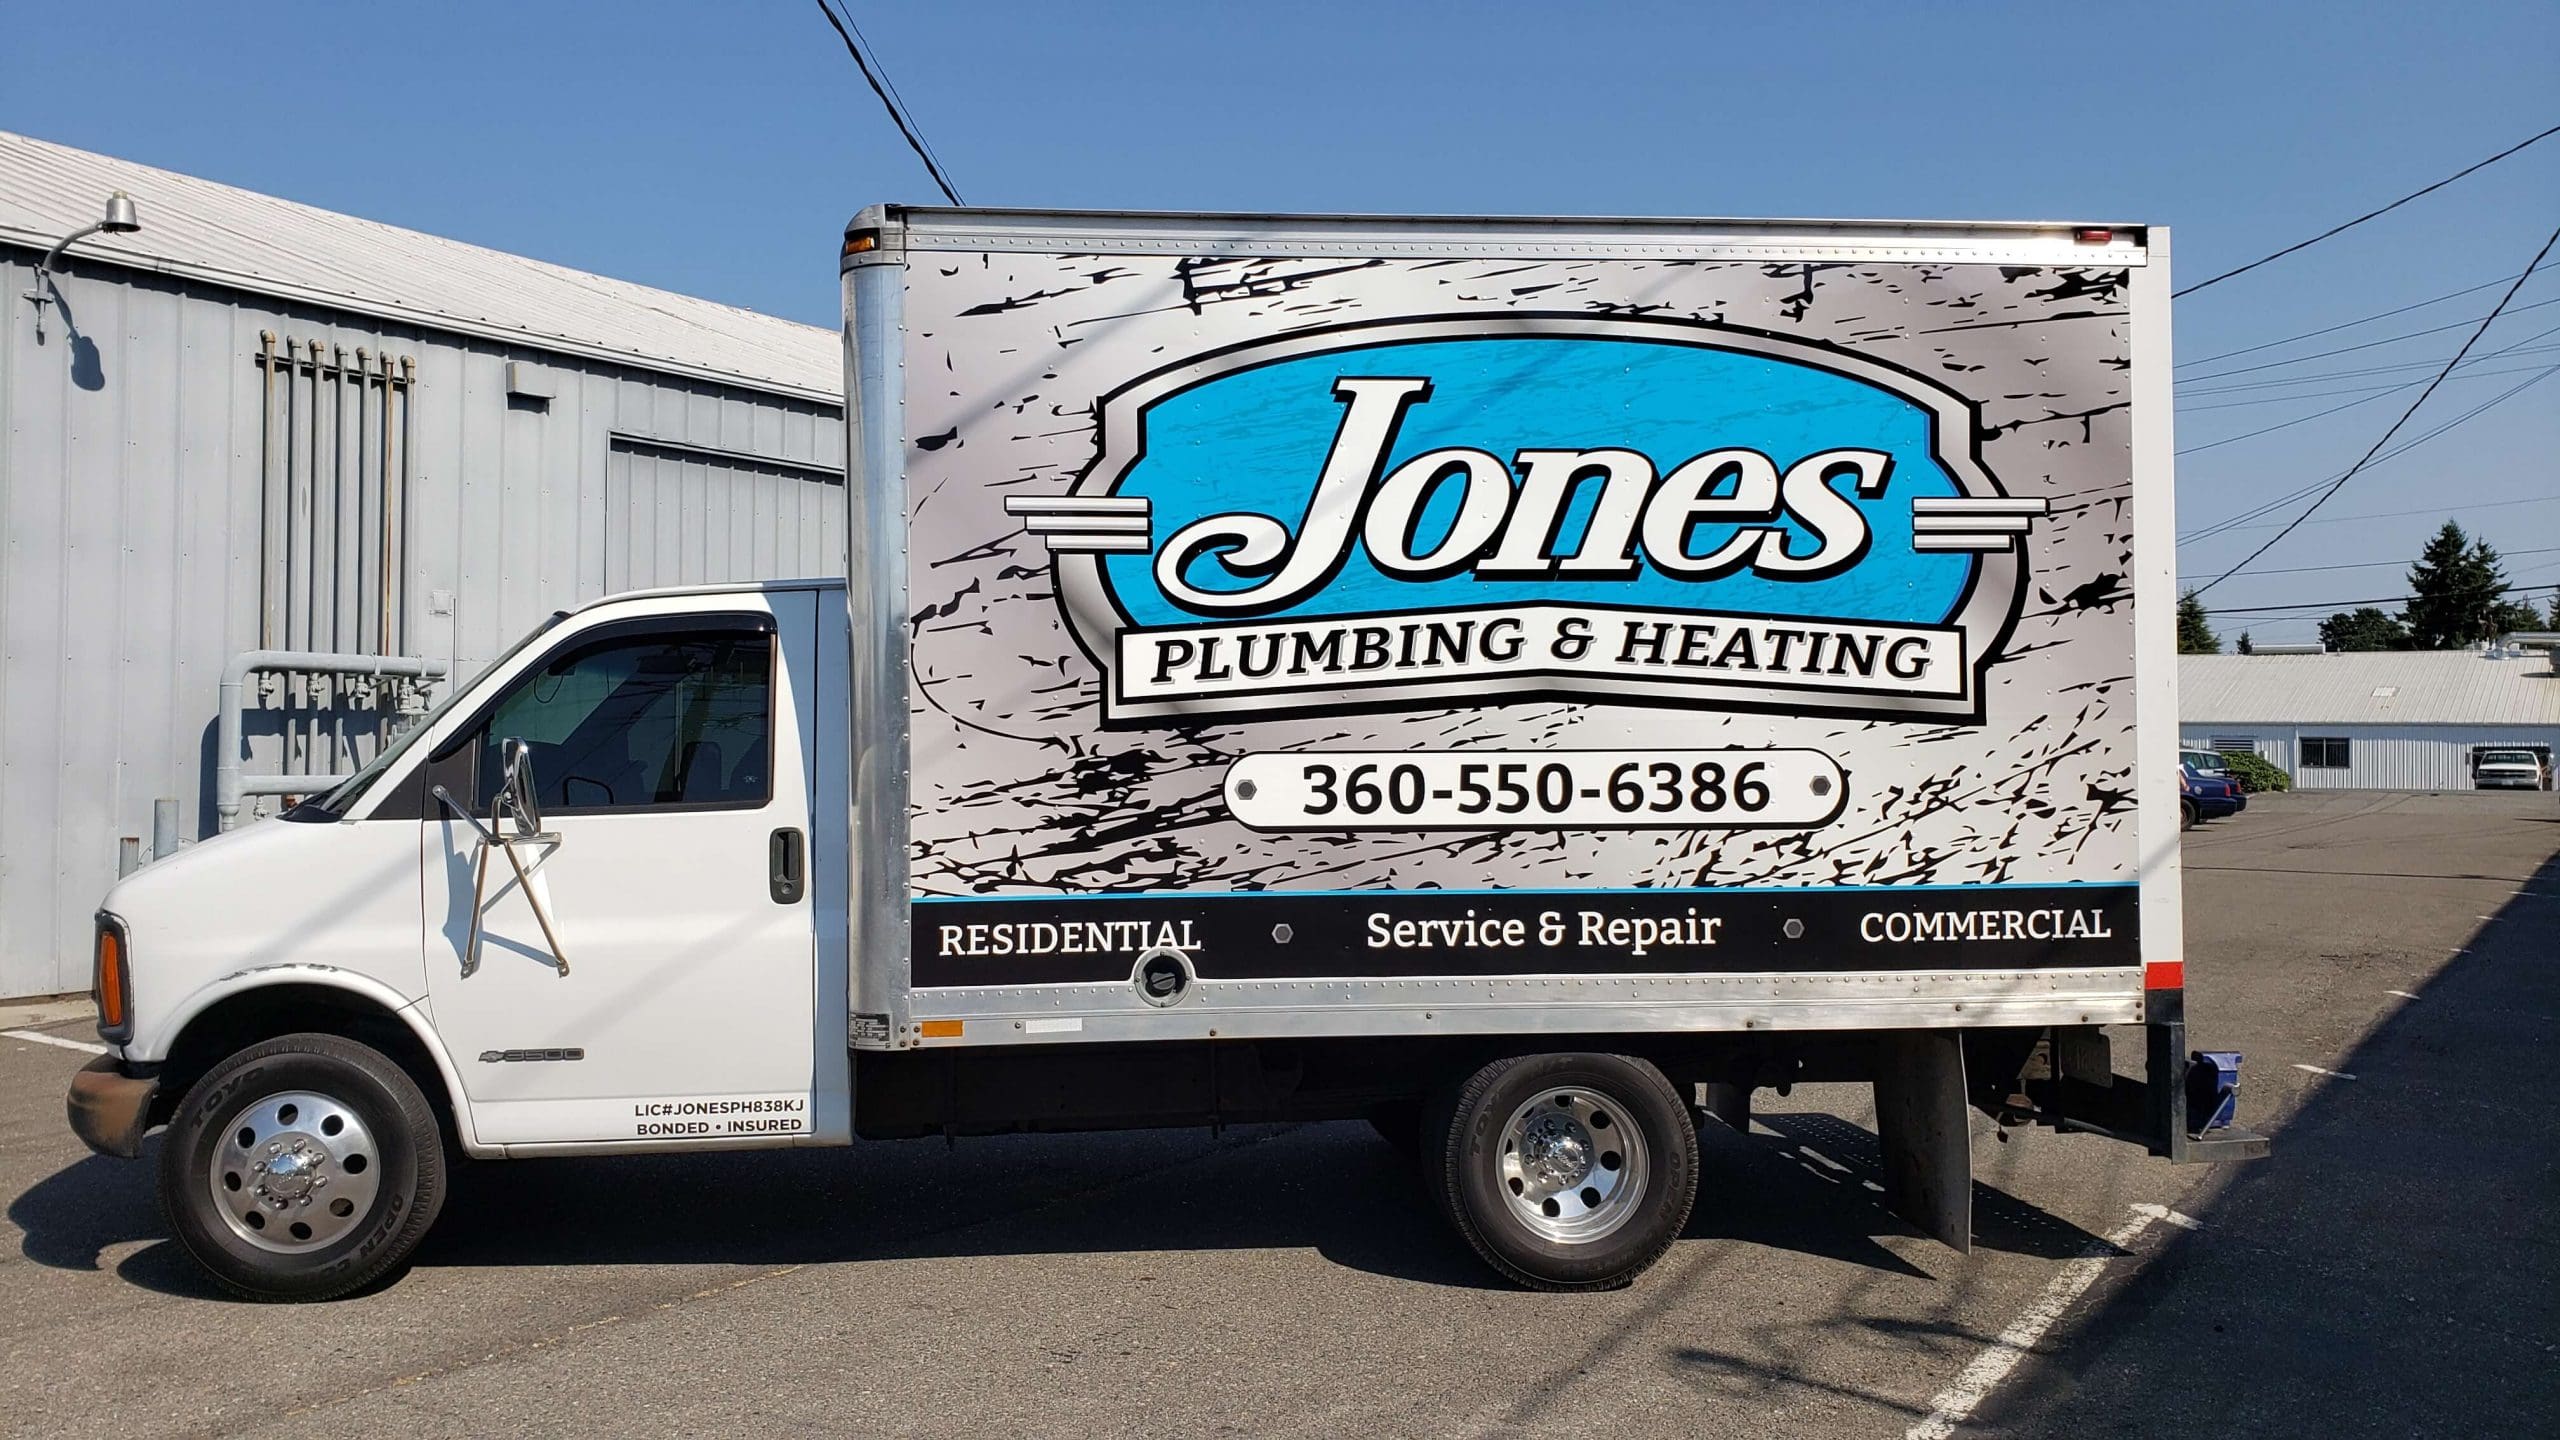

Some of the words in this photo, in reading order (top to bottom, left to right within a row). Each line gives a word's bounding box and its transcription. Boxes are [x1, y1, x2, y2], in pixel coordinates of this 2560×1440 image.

[1152, 376, 1896, 617] Jones
[1150, 617, 1527, 684] PLUMBING
[1550, 616, 1595, 661] &
[1615, 620, 1932, 681] HEATING
[1302, 761, 1772, 816] 360-550-6386
[938, 919, 1202, 956] RESIDENTIAL
[1366, 908, 1526, 948] Service
[1538, 911, 1567, 946] &
[1577, 907, 1722, 956] Repair
[1860, 908, 2113, 943] COMMERCIAL
[634, 1099, 805, 1117] LIC#JONESPH838KJ
[636, 1121, 710, 1136] BONDED
[727, 1118, 803, 1133] INSURED
